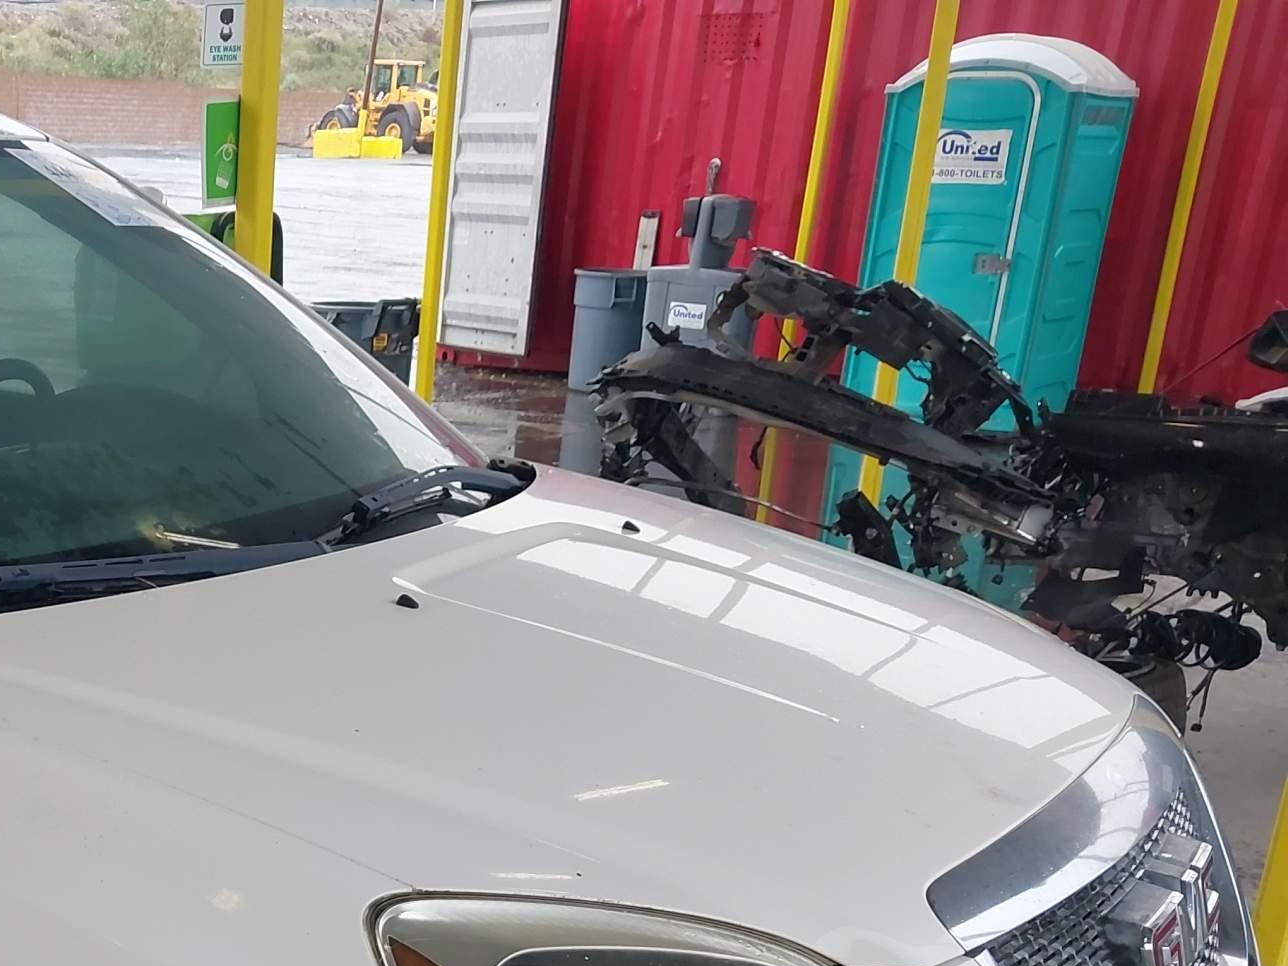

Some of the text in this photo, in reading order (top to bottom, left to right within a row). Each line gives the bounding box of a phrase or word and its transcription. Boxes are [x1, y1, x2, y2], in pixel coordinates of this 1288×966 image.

[209, 44, 242, 53] EYE WASH
[212, 54, 238, 62] STATION
[673, 309, 704, 320] United
